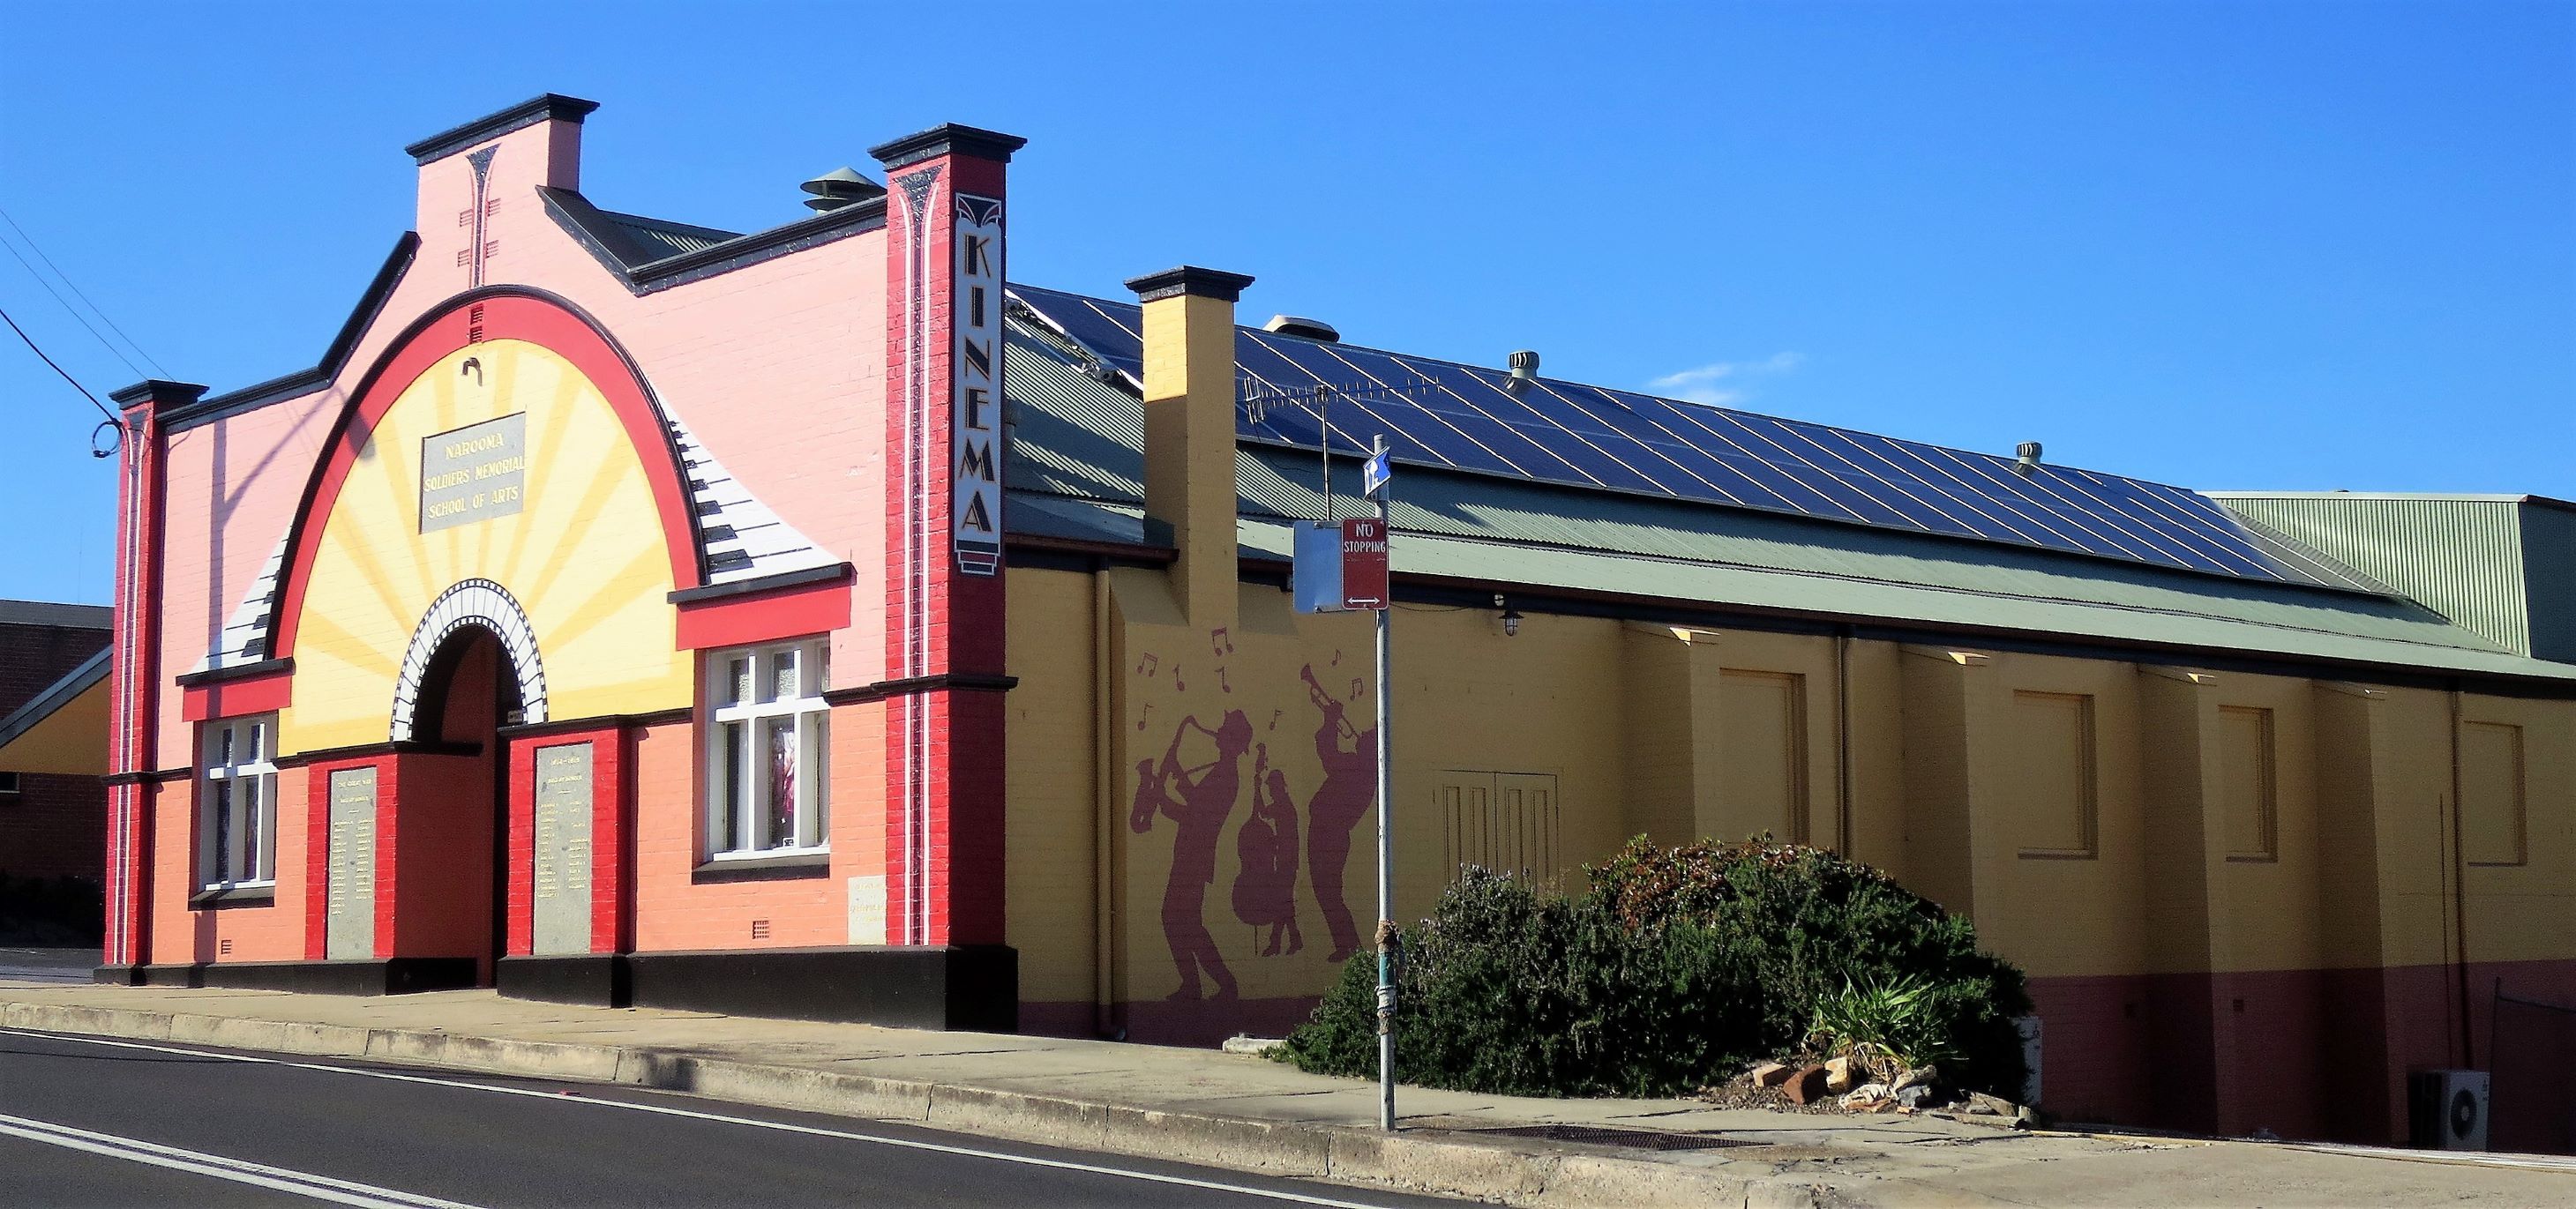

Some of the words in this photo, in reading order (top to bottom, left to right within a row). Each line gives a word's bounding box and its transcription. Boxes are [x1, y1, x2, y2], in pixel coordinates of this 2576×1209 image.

[959, 234, 995, 533] KINEMA
[446, 433, 505, 459] NAROOMA
[423, 468, 471, 493] SOLDIERS
[475, 455, 526, 481] MEMORIAL
[428, 497, 467, 519] SCHOOL
[472, 493, 485, 509] OF
[490, 486, 519, 505] ARTS
[1355, 523, 1374, 537] NO
[1344, 541, 1386, 553] STOPPING
